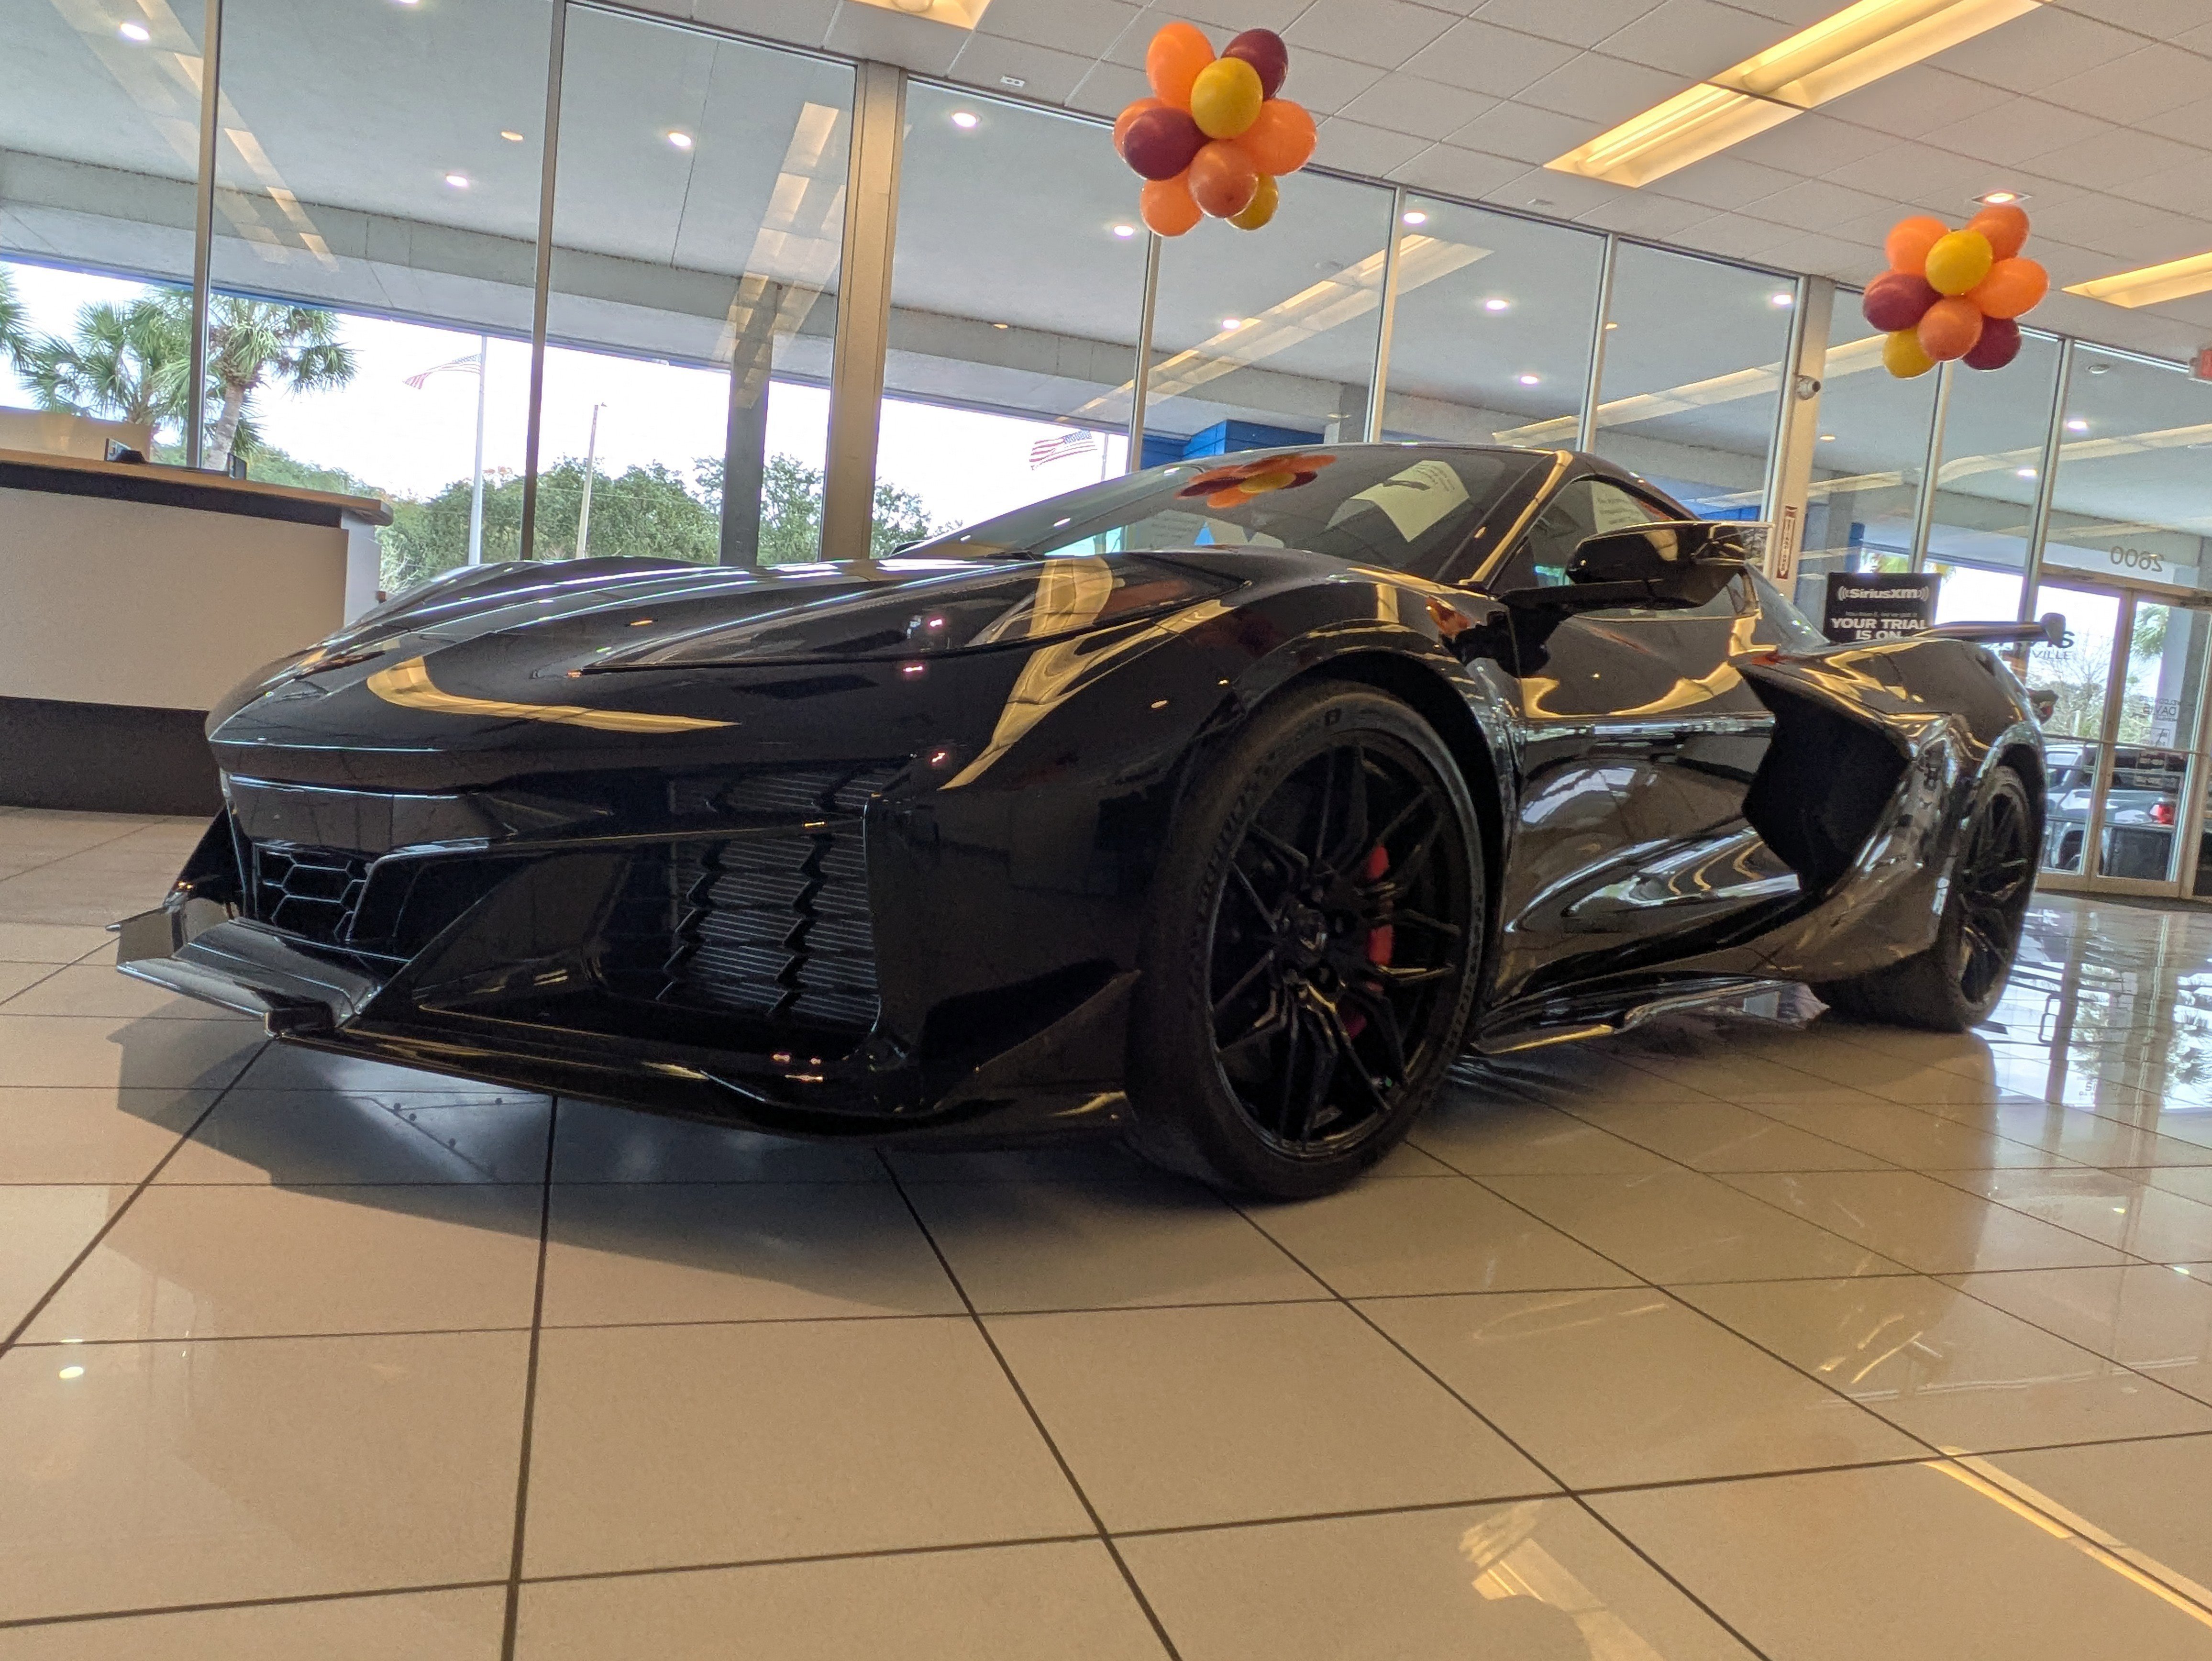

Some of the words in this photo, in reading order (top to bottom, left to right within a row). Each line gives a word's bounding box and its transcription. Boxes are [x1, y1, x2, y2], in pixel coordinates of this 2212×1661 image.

[1831, 618, 1876, 629] YOUR
[1880, 619, 1928, 629] TRIAL
[1856, 630, 1872, 640] IS
